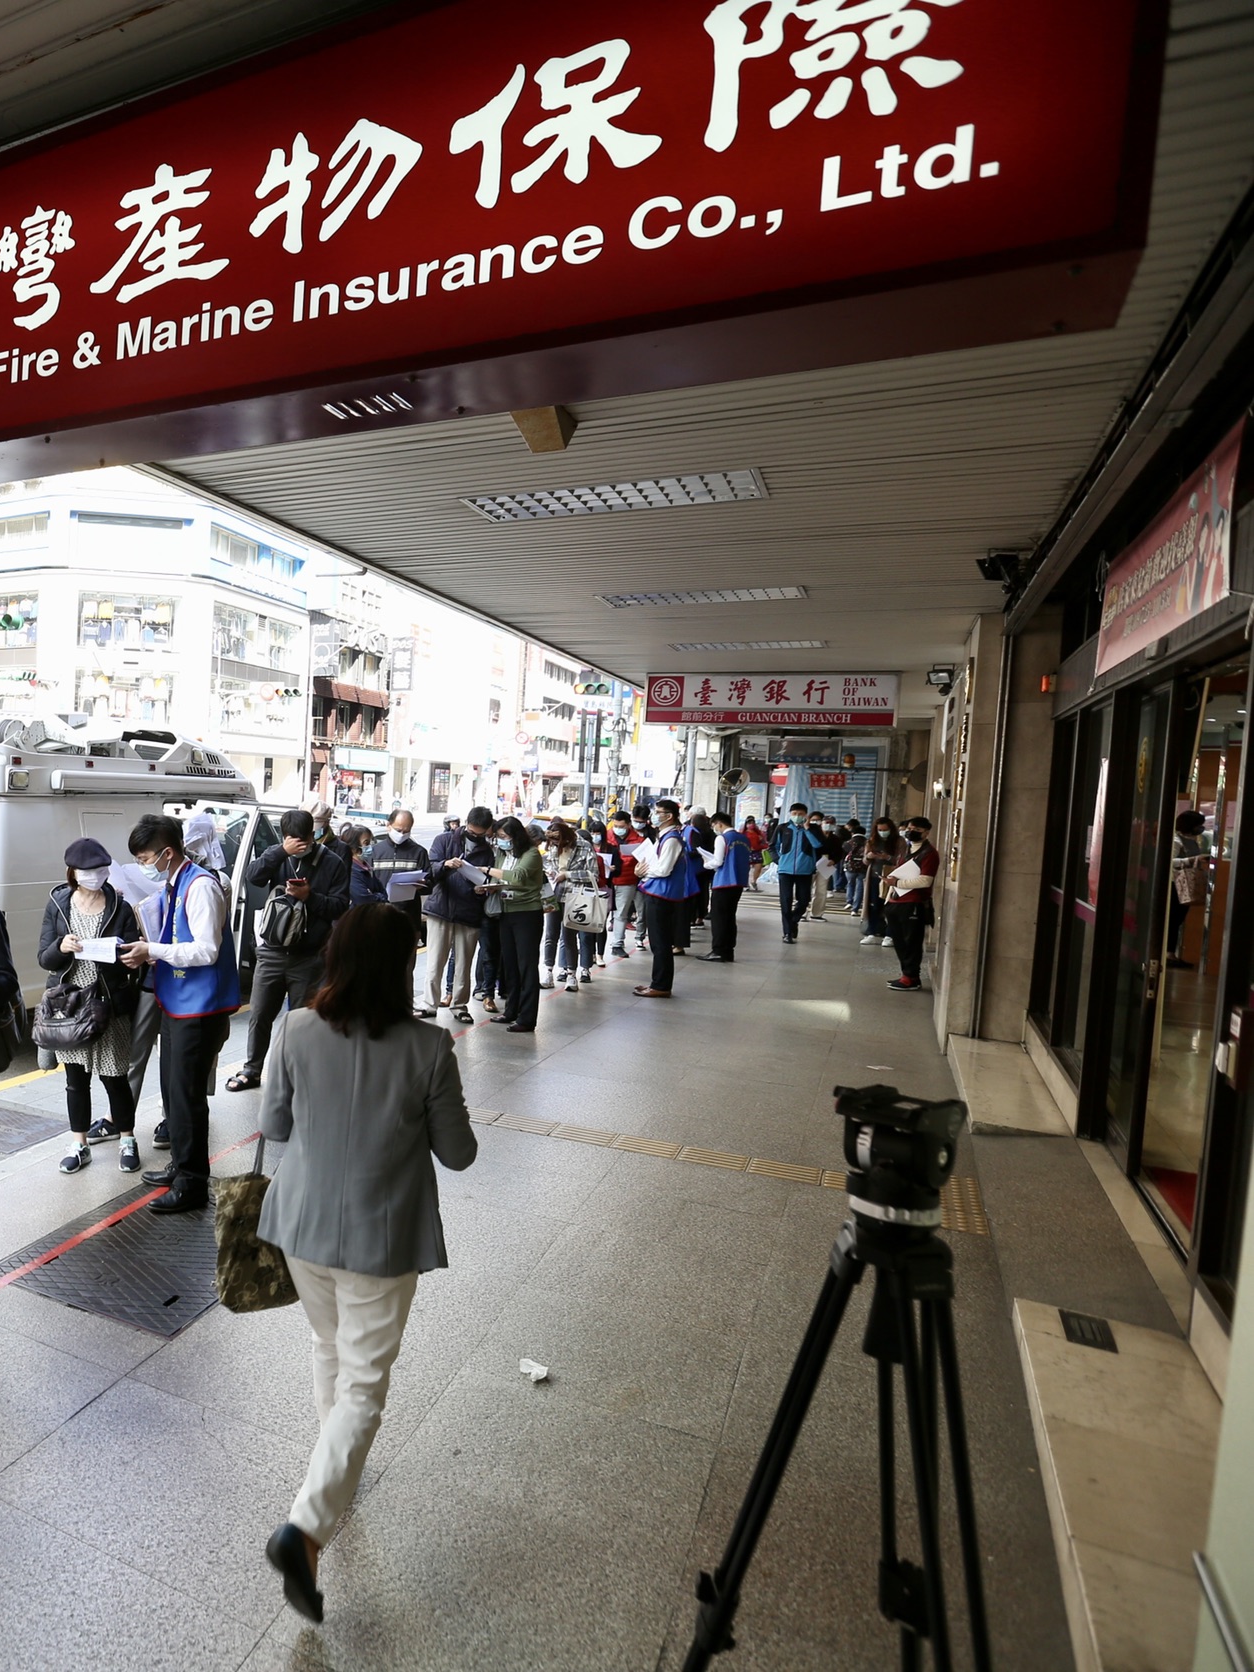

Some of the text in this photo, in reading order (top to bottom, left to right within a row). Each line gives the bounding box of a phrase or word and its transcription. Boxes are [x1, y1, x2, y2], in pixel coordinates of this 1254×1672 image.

[73, 332, 102, 370] &
[117, 299, 274, 361] Marine
[293, 226, 604, 323] Insurance
[629, 196, 783, 250] Co.,
[819, 124, 1000, 212] Ltd.
[843, 677, 877, 687] BANK
[694, 678, 831, 706] 臺灣銀行
[842, 687, 859, 697] OF
[841, 697, 889, 707] TAIWAN
[737, 712, 851, 723] GUANCIAN BRANCH
